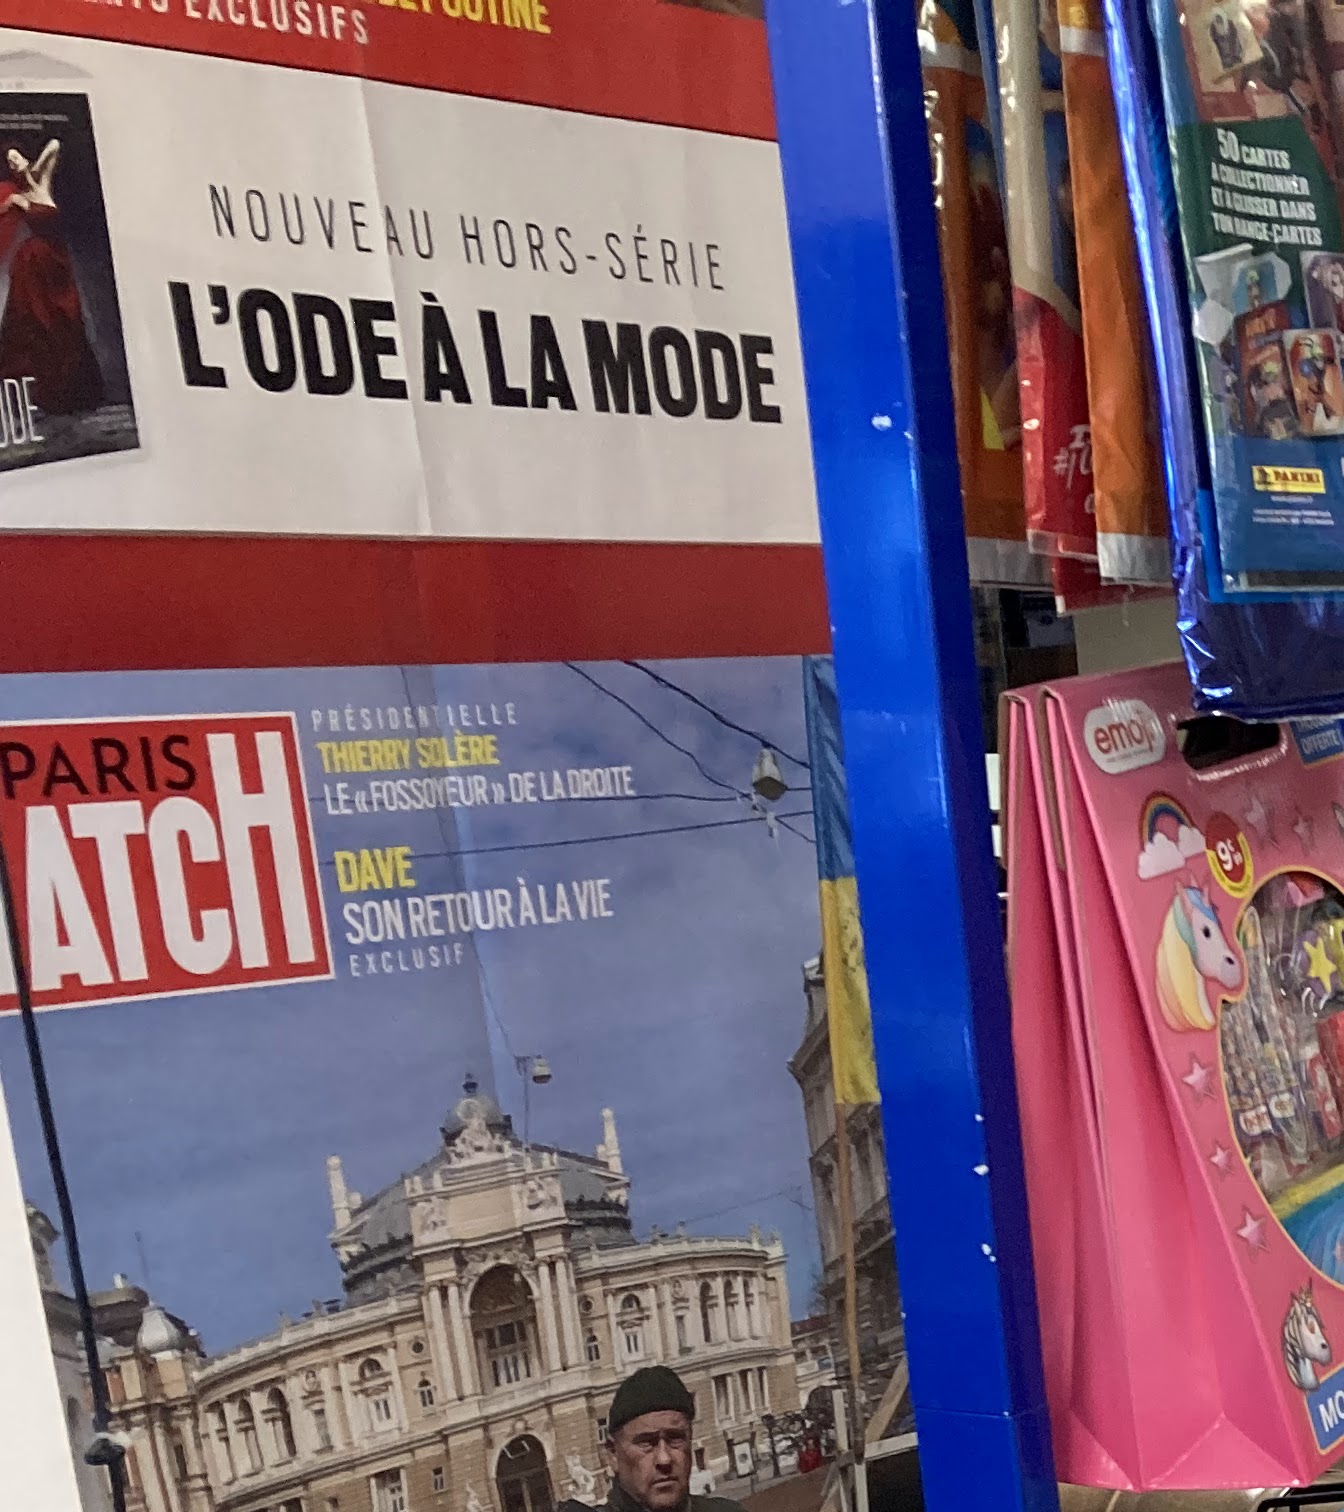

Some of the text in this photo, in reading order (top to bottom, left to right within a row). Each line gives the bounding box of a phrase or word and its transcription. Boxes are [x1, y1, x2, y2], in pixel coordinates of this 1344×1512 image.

[209, 183, 725, 292] NOUVEAU HORS-SÉRIE
[167, 279, 783, 424] L'ODE À LA MODE
[312, 702, 518, 733] PRÉSIDENTIELLE
[2, 733, 199, 799] PARIS
[315, 729, 499, 774] THIERRY SOLÈRE
[324, 766, 637, 816] LE DE LA DROITE
[0, 731, 317, 995] ATCH
[334, 846, 416, 892] DAVE
[343, 879, 613, 946] SON RETOUR LA VIE
[349, 942, 464, 977] EXCLUSIF
